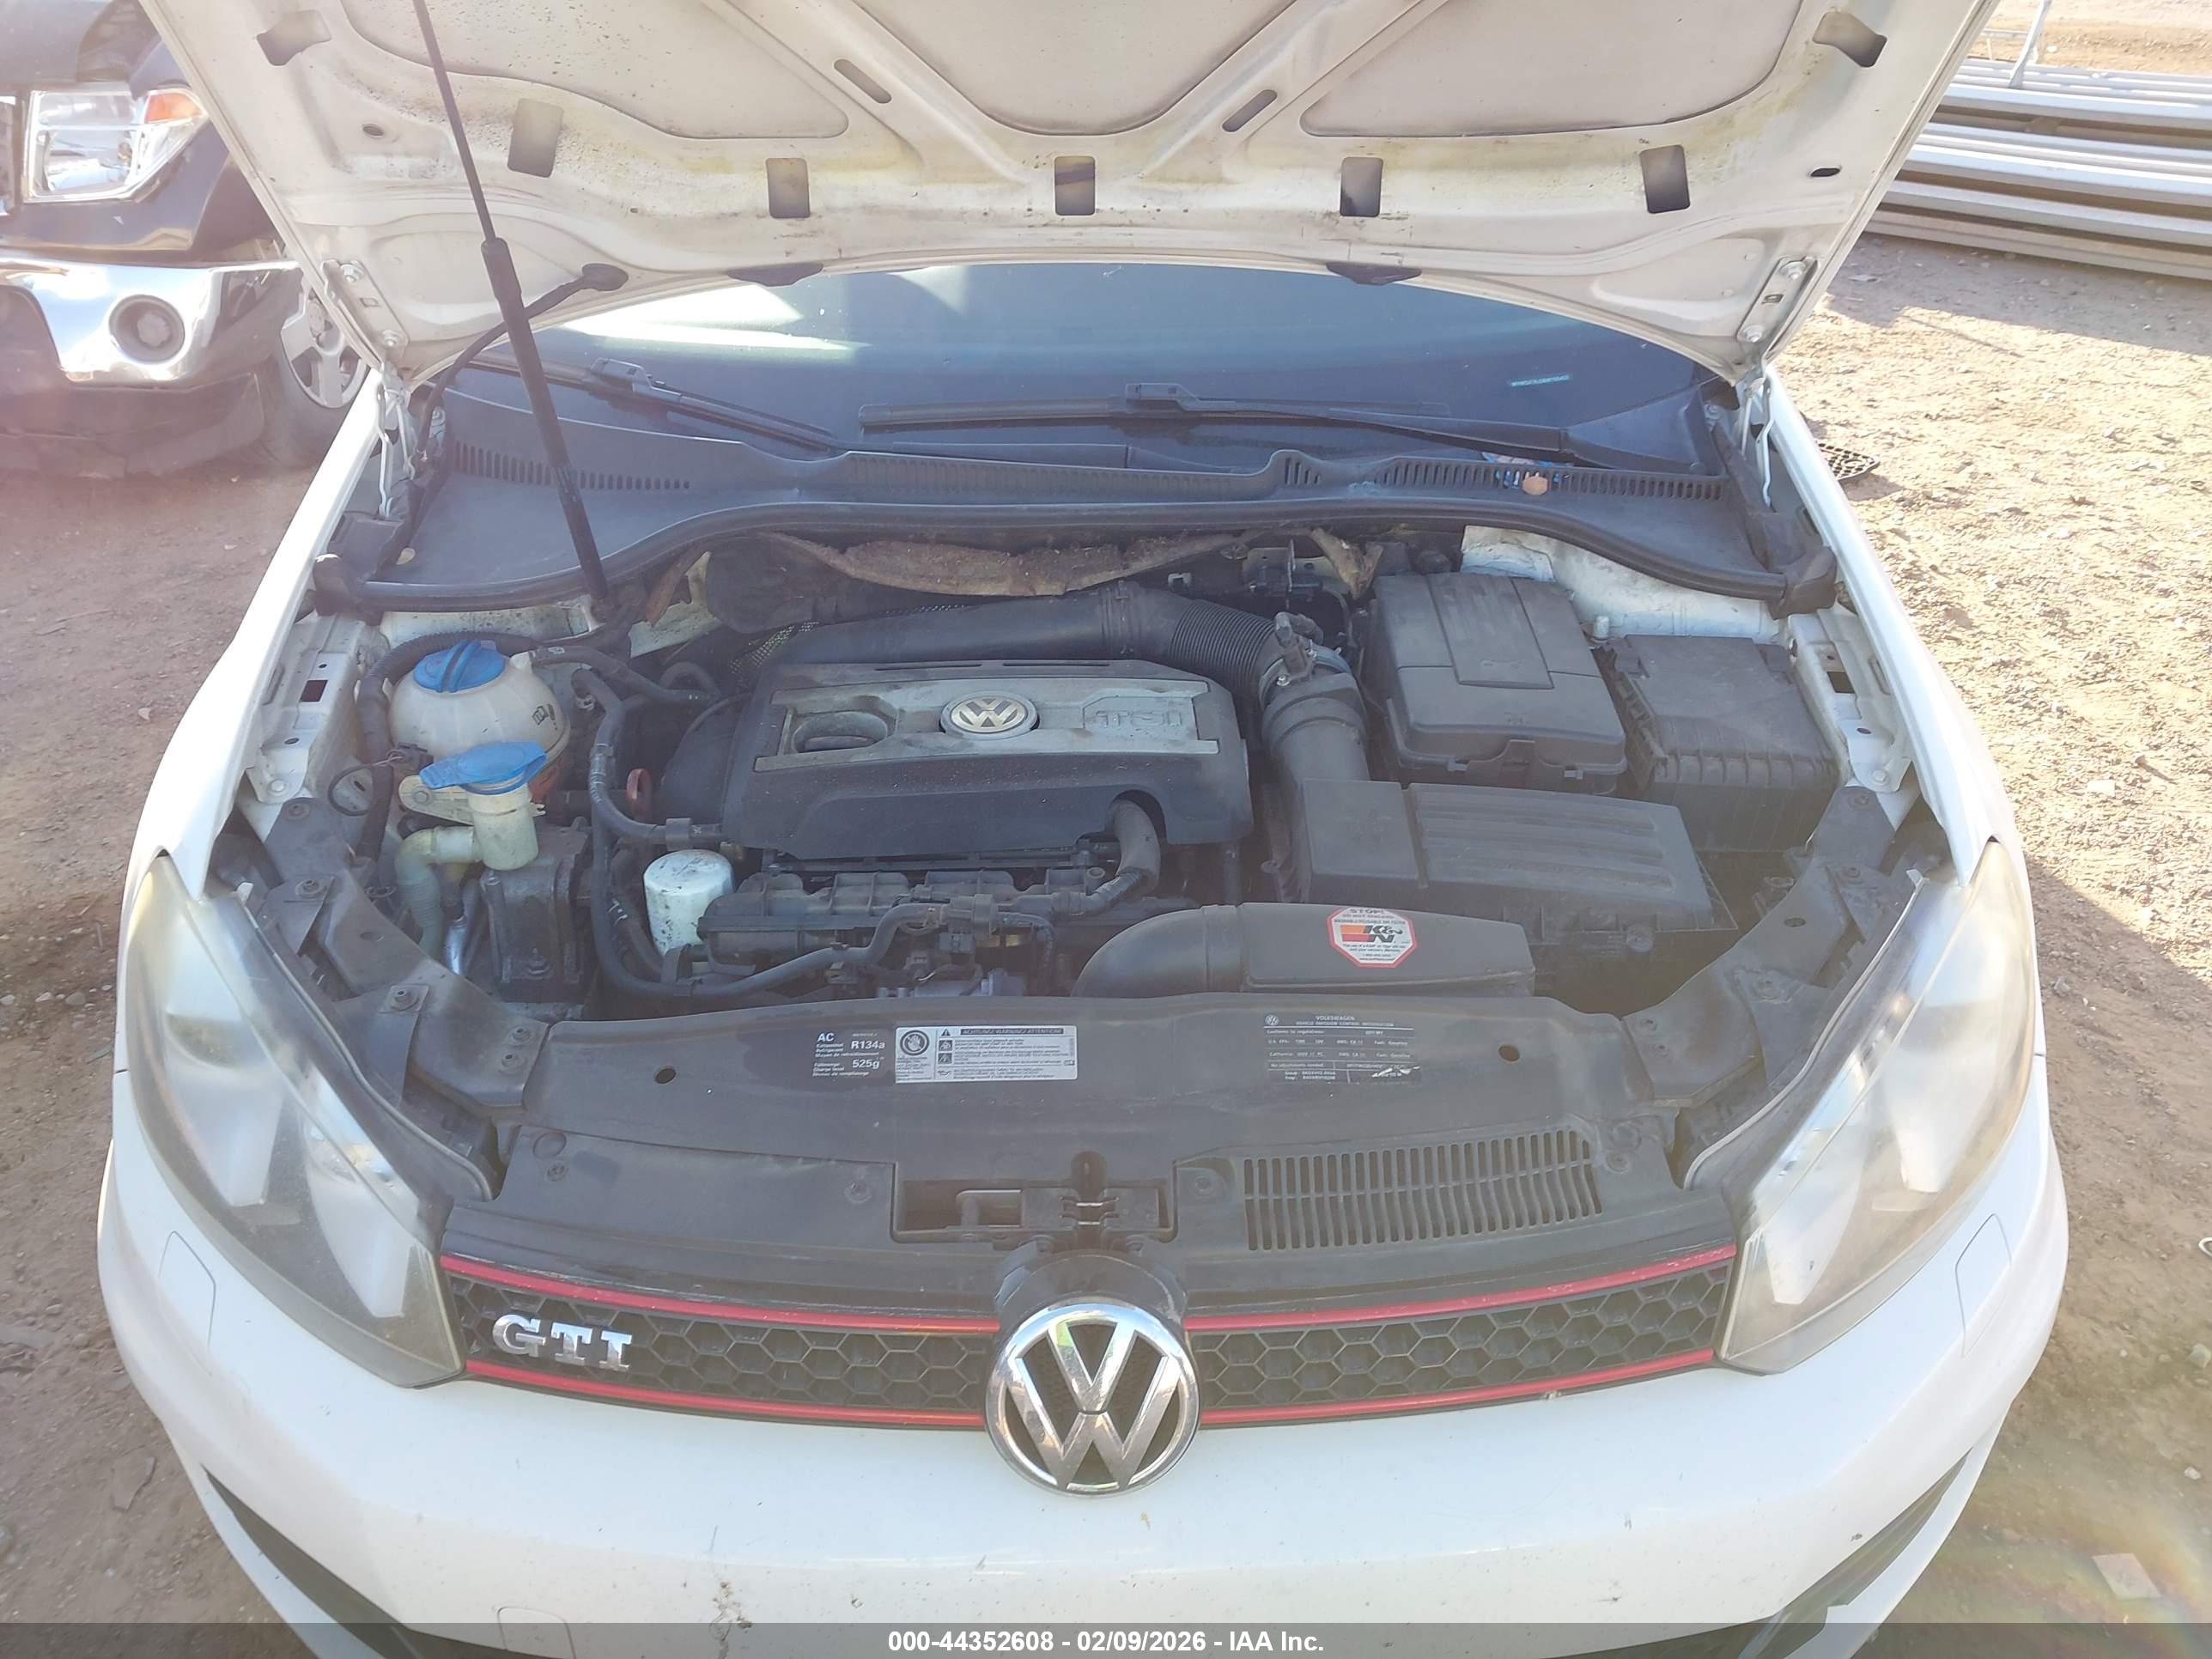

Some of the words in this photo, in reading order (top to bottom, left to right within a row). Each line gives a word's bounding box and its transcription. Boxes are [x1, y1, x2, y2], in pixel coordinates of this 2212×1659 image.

[817, 1033, 835, 1042] AC
[851, 1041, 885, 1049] R134a
[852, 1059, 880, 1070] 525g
[492, 1314, 633, 1372] GTI
[985, 1298, 1200, 1497] VW
